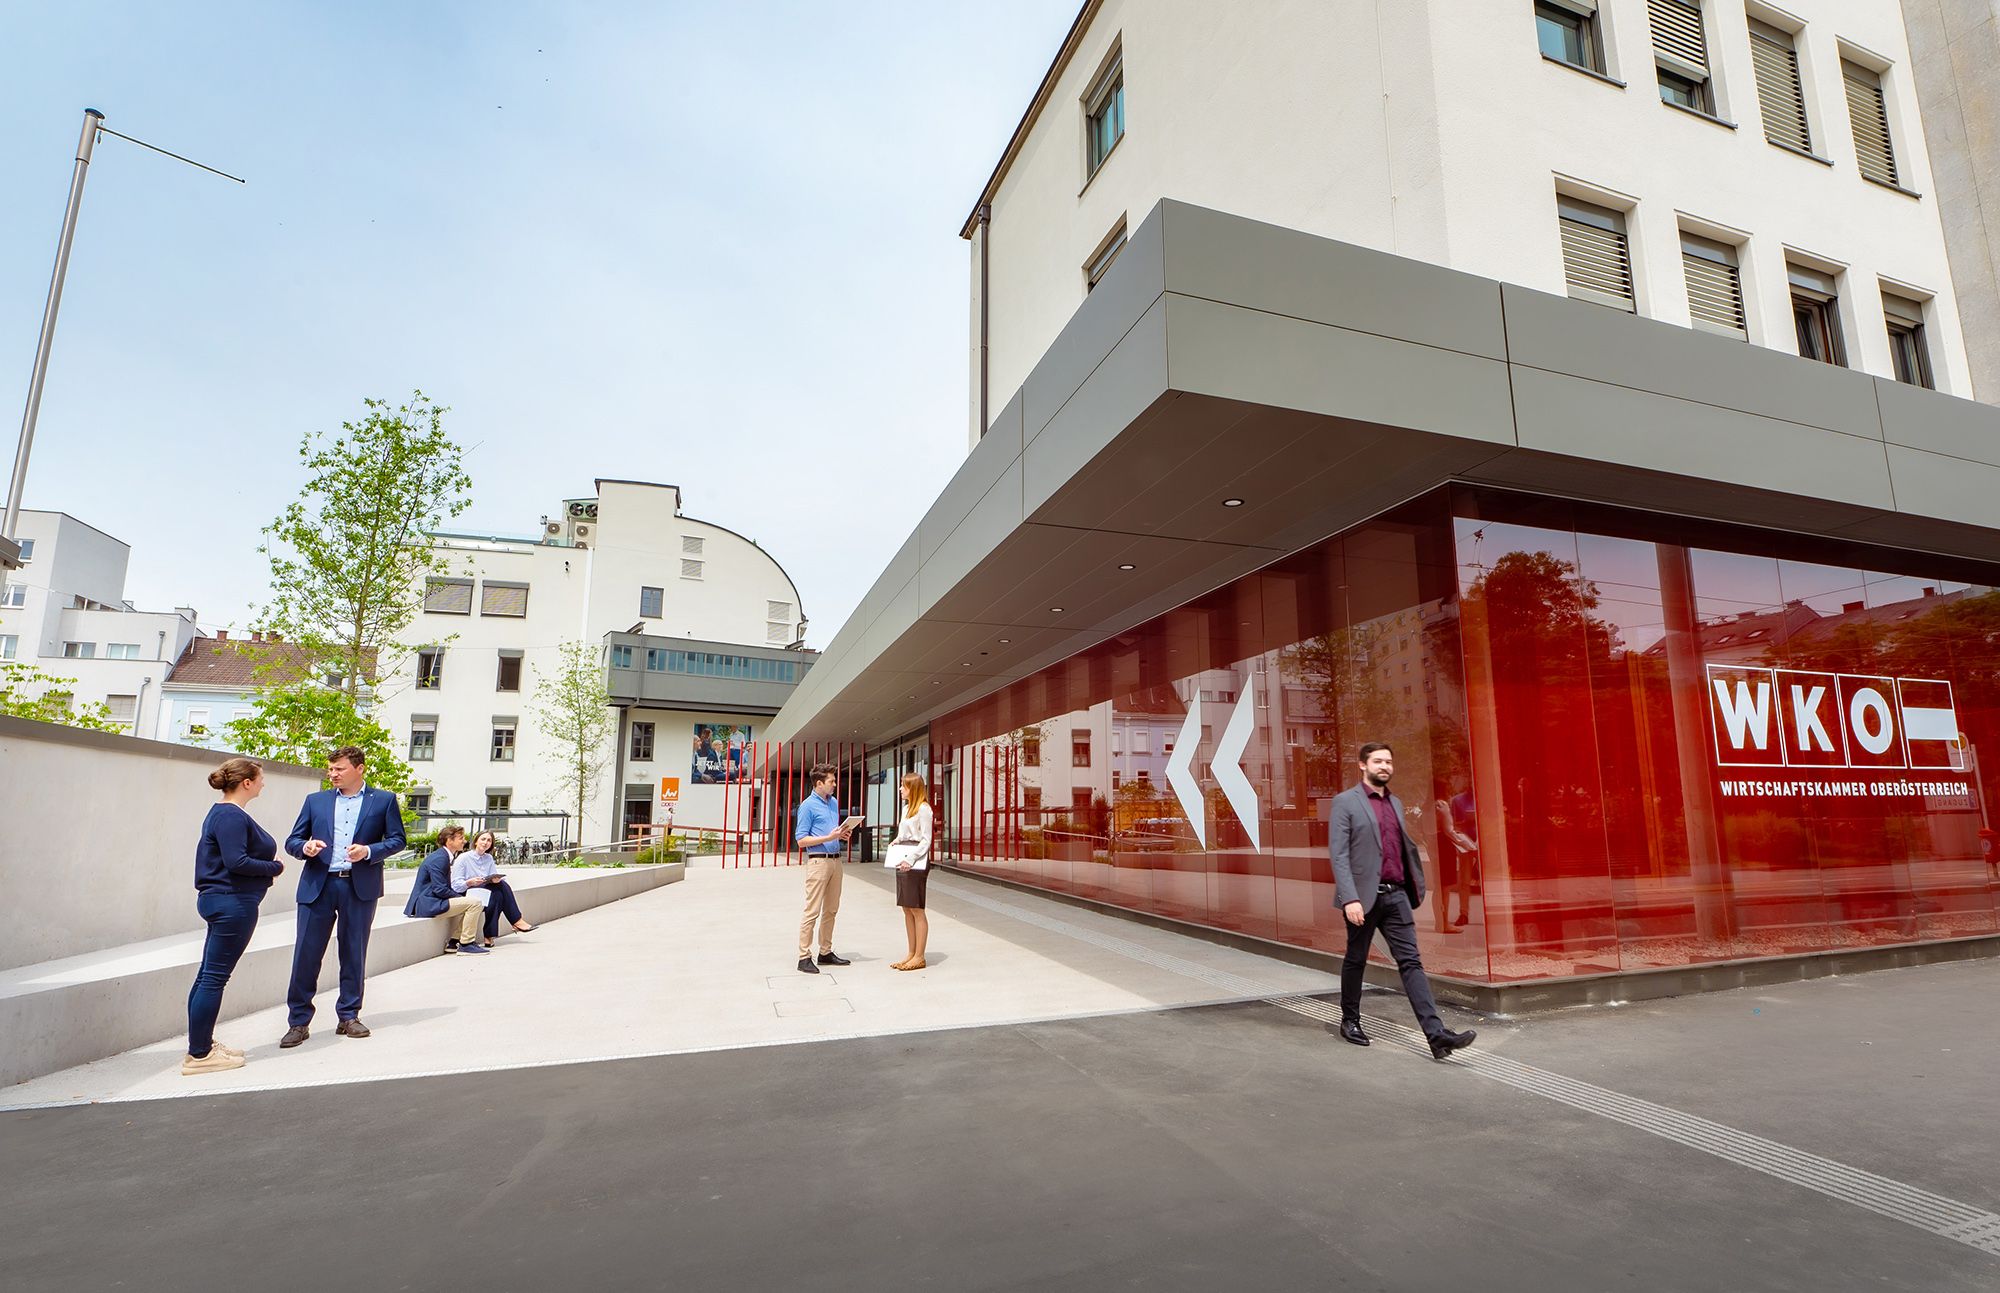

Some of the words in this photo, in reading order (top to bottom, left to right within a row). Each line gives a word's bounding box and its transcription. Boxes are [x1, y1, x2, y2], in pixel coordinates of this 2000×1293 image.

[1712, 679, 1893, 754] WKO
[1719, 780, 1867, 796] WIRTSCHAFTSKAMMER
[1870, 779, 1968, 796] OBERÖSTERREICH
